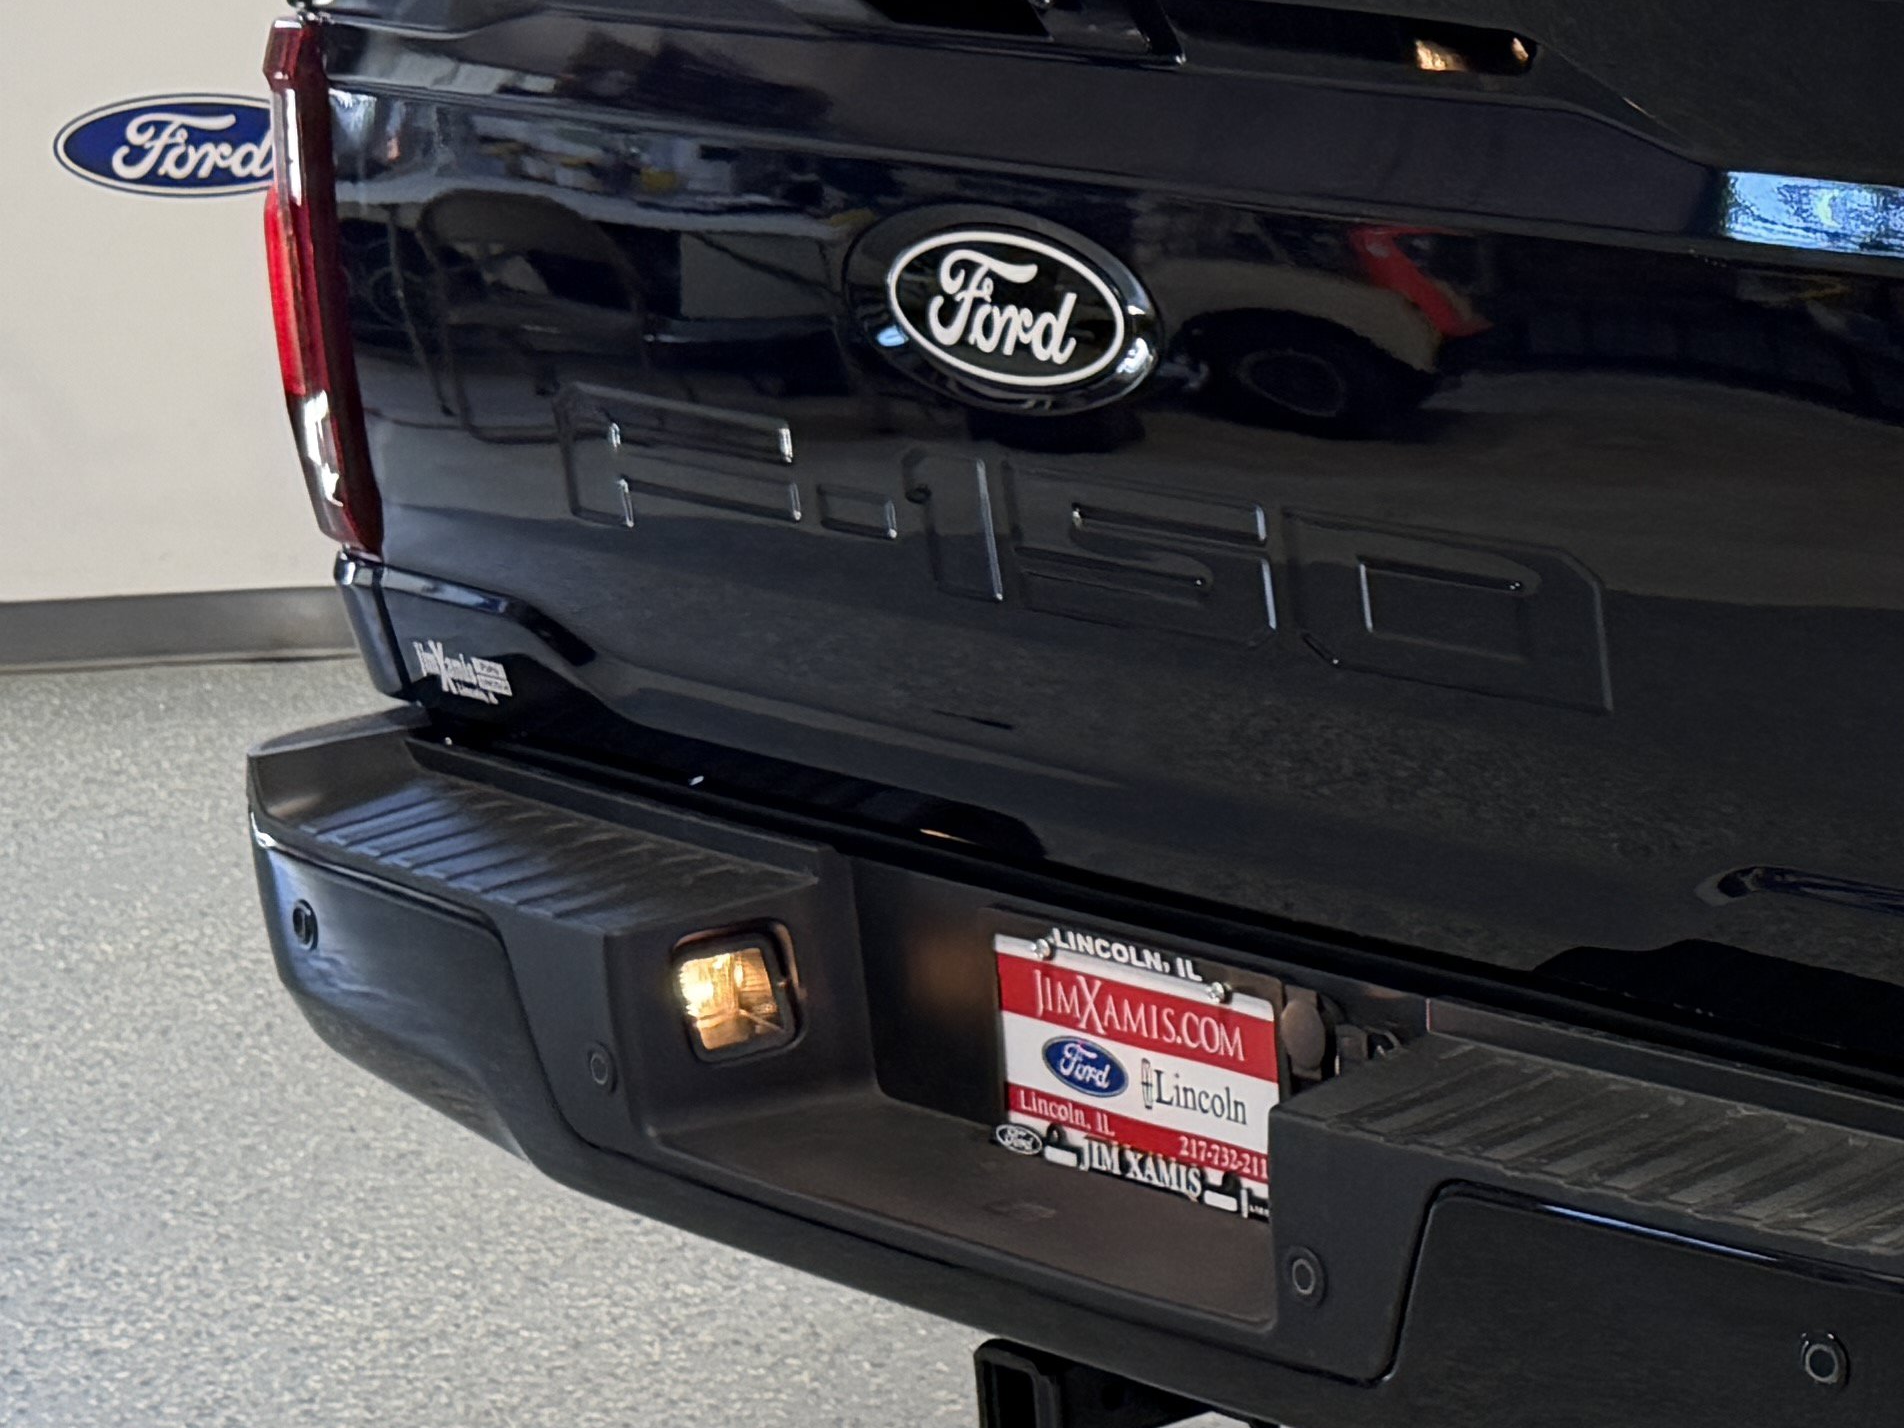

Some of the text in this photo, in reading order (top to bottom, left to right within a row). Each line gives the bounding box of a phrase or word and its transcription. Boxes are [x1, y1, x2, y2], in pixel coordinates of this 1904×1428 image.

[111, 112, 274, 180] Ford
[928, 249, 1078, 364] Ford
[1050, 927, 1202, 981] LINCOLN, IL
[1034, 969, 1245, 1061] JIMXAMIS.COM
[1058, 1039, 1111, 1089] Ford
[1095, 1112, 1115, 1137] IL
[1156, 1069, 1248, 1126] Lincoln
[1078, 1138, 1203, 1198] JIM XAMIS
[1179, 1136, 1269, 1179] 217-732-211
